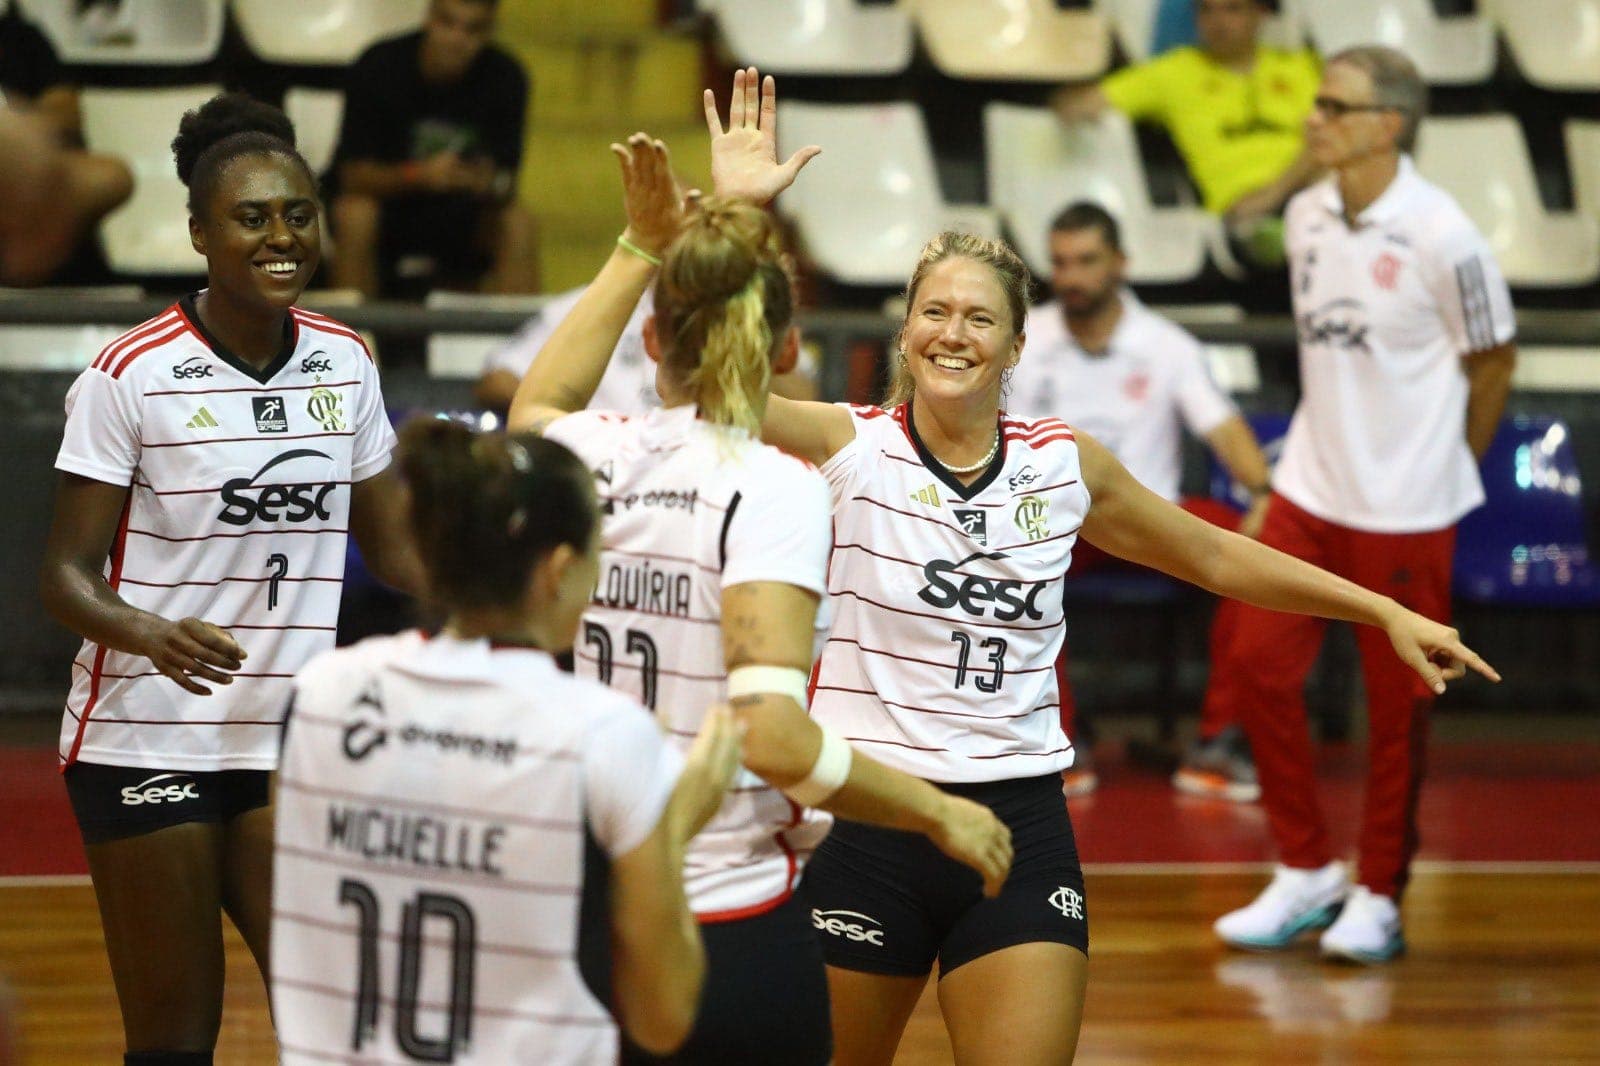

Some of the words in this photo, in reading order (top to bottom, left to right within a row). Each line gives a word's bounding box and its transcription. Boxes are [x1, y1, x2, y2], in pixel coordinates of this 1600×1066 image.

[172, 364, 214, 379] Sesc
[301, 358, 333, 374] Sesc
[217, 477, 337, 526] Sesc
[591, 561, 691, 618] LQUÍRIA
[917, 558, 1047, 622] Sesc
[950, 630, 1008, 694] 13
[120, 781, 200, 806] Sesc
[326, 802, 507, 876] MICHELLE
[811, 907, 885, 947] Sesc
[337, 877, 477, 1065] 10
